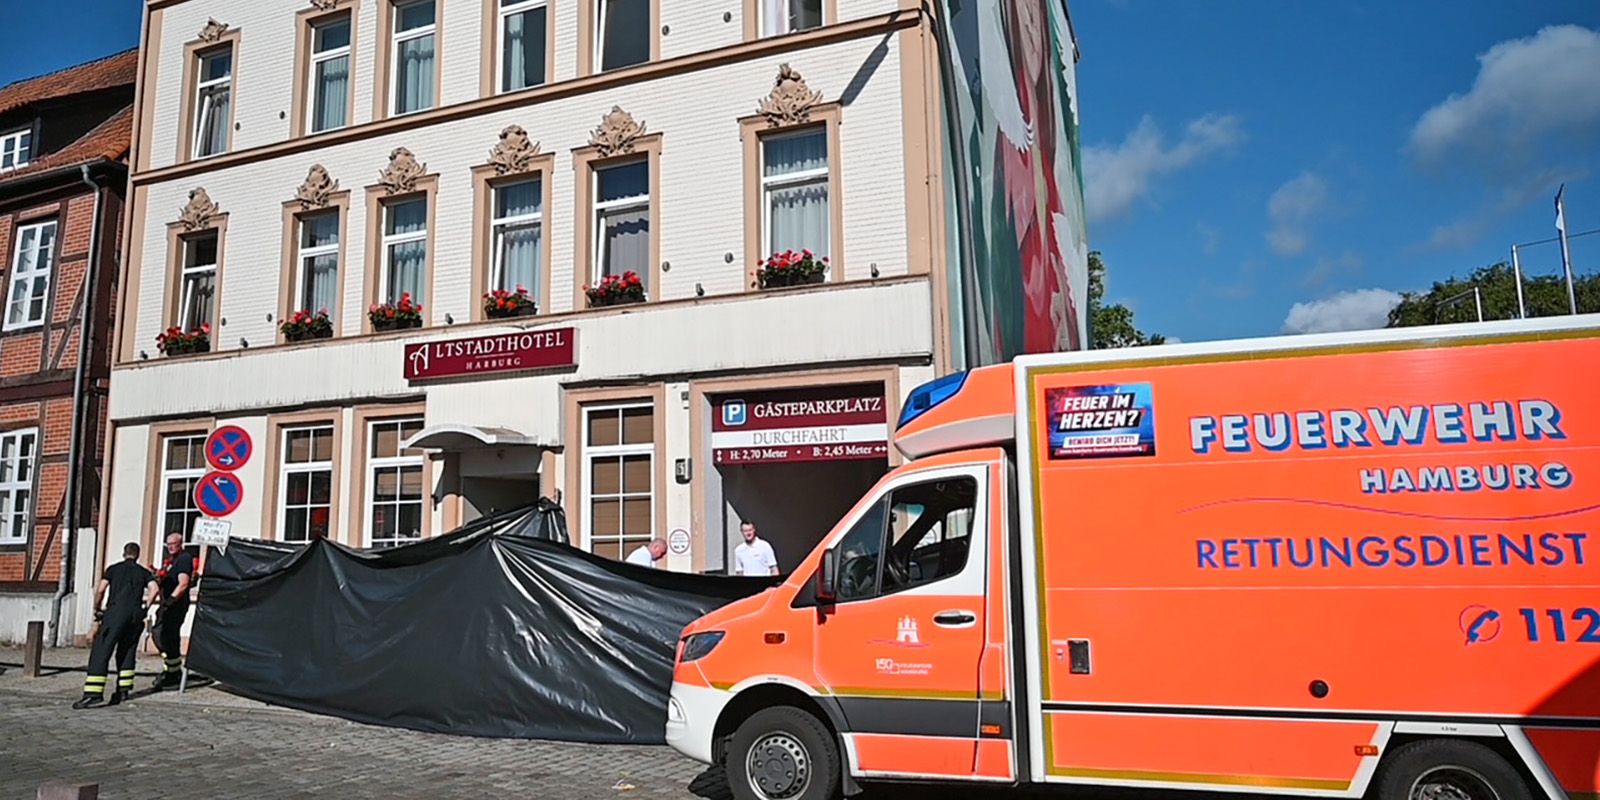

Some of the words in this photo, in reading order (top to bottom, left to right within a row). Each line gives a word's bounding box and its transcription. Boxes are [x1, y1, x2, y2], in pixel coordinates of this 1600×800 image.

[409, 332, 564, 375] ALTSTADTHOTEL
[466, 357, 521, 371] HARBURG
[728, 404, 741, 421] P
[754, 397, 881, 418] GÄSTEPARKPLATZ
[1063, 395, 1109, 412] FEUER
[1111, 394, 1131, 409] IM
[1060, 409, 1139, 430] HERZEN?
[1189, 399, 1568, 454] FEUERWEHR
[753, 428, 848, 445] DURCHFAHRT
[1068, 437, 1094, 446] BEWIRB
[1096, 436, 1112, 445] DICH
[730, 450, 741, 460] H:
[742, 449, 761, 461] 2,70
[762, 448, 788, 459] Meter
[813, 447, 824, 457] B:
[824, 446, 843, 458] 2,45
[845, 445, 872, 456] Meter
[1360, 462, 1573, 493] HAMBURG
[1196, 532, 1587, 568] RETTUNGSDIENST
[1518, 607, 1600, 642] 112
